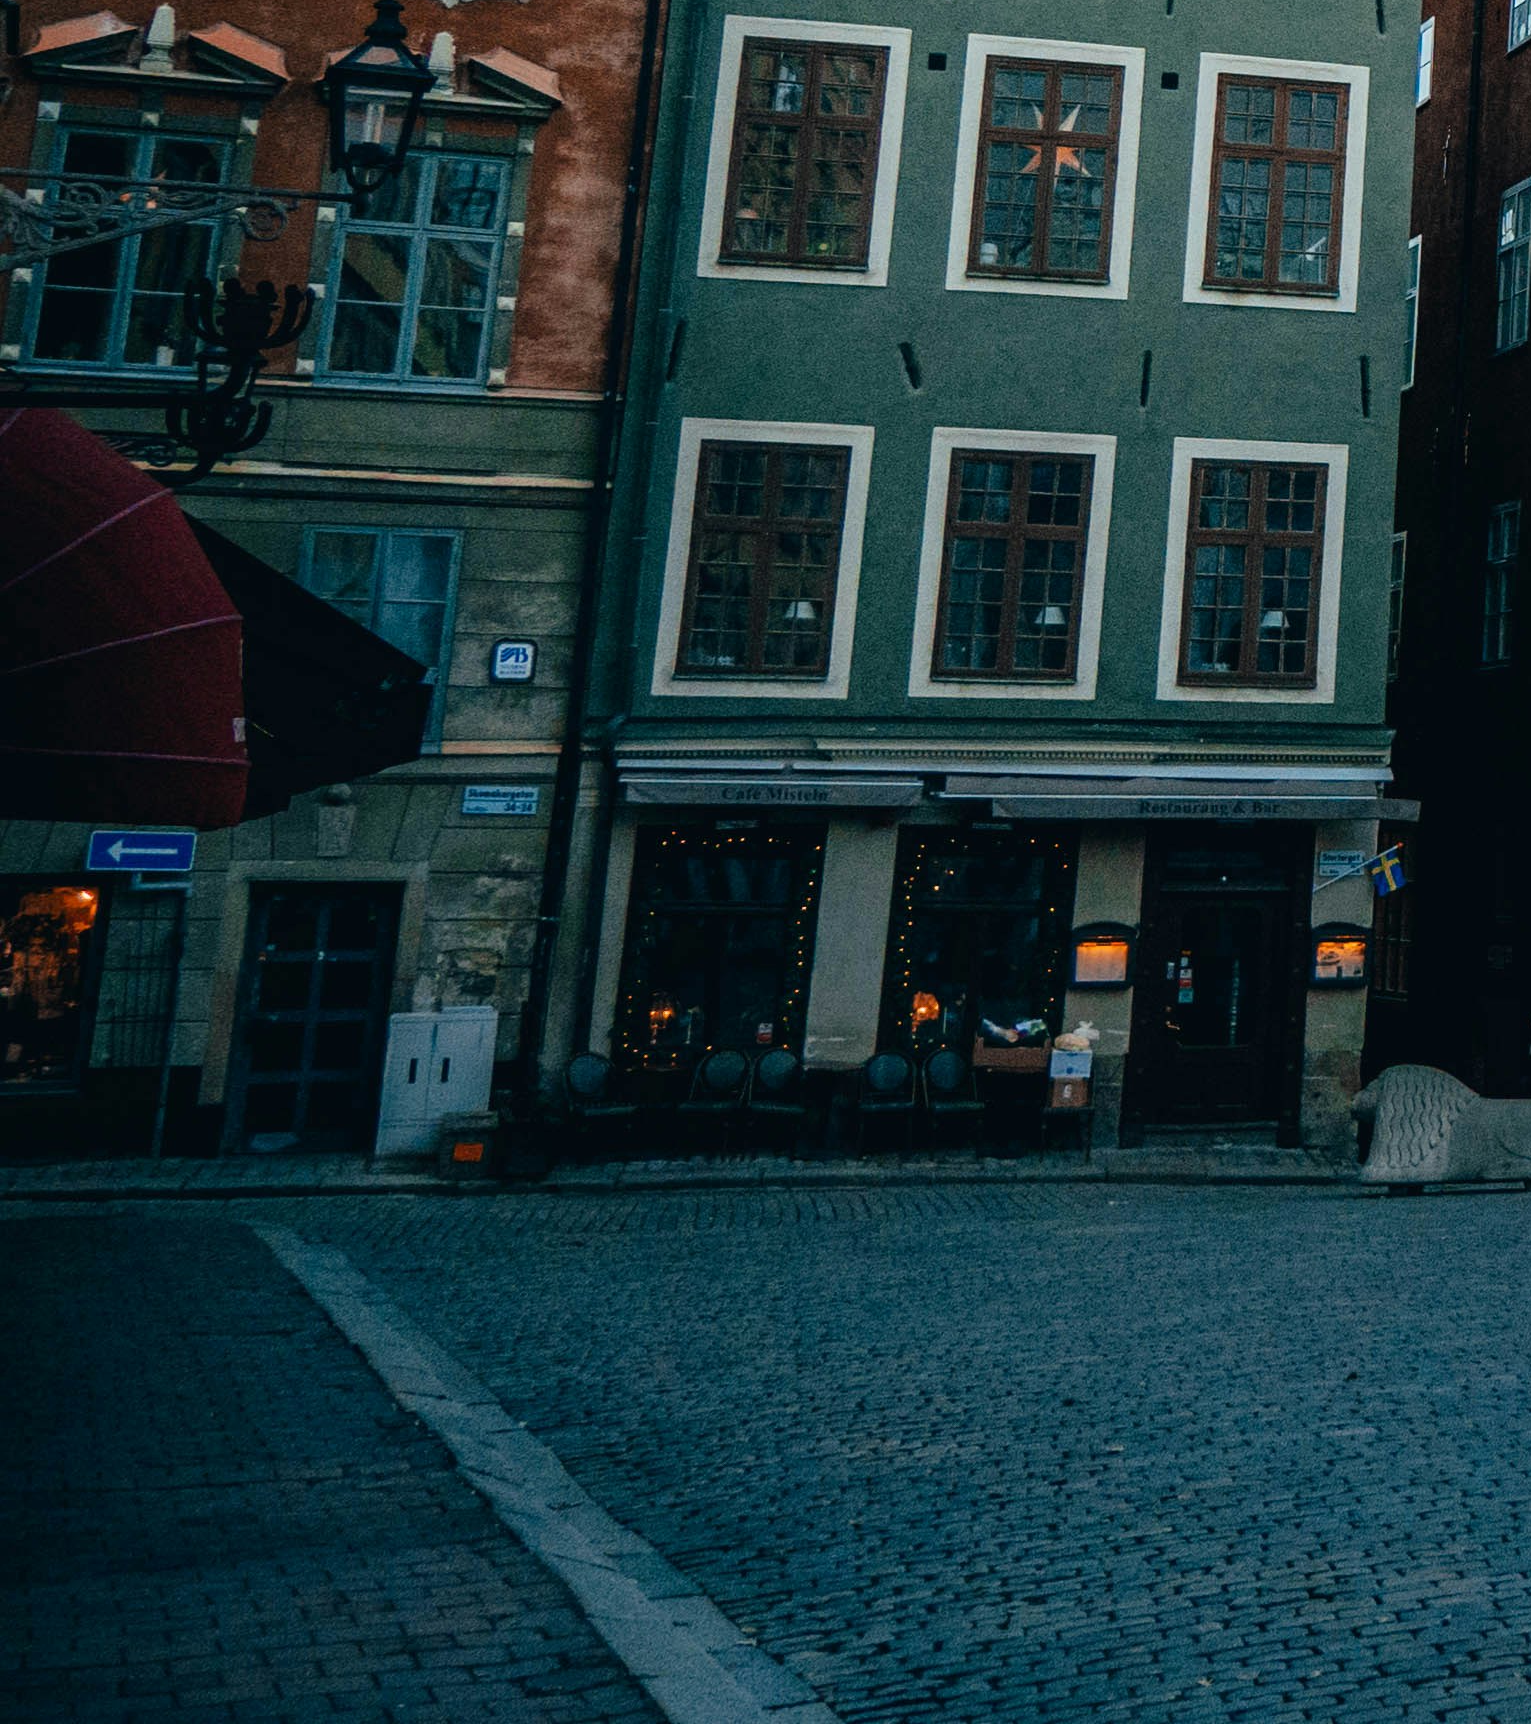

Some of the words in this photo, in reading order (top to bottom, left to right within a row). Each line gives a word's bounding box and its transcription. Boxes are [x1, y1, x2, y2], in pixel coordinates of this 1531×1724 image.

[1139, 799, 1229, 816] Restaurang
[1233, 801, 1245, 813] &
[1252, 801, 1281, 814] Bar
